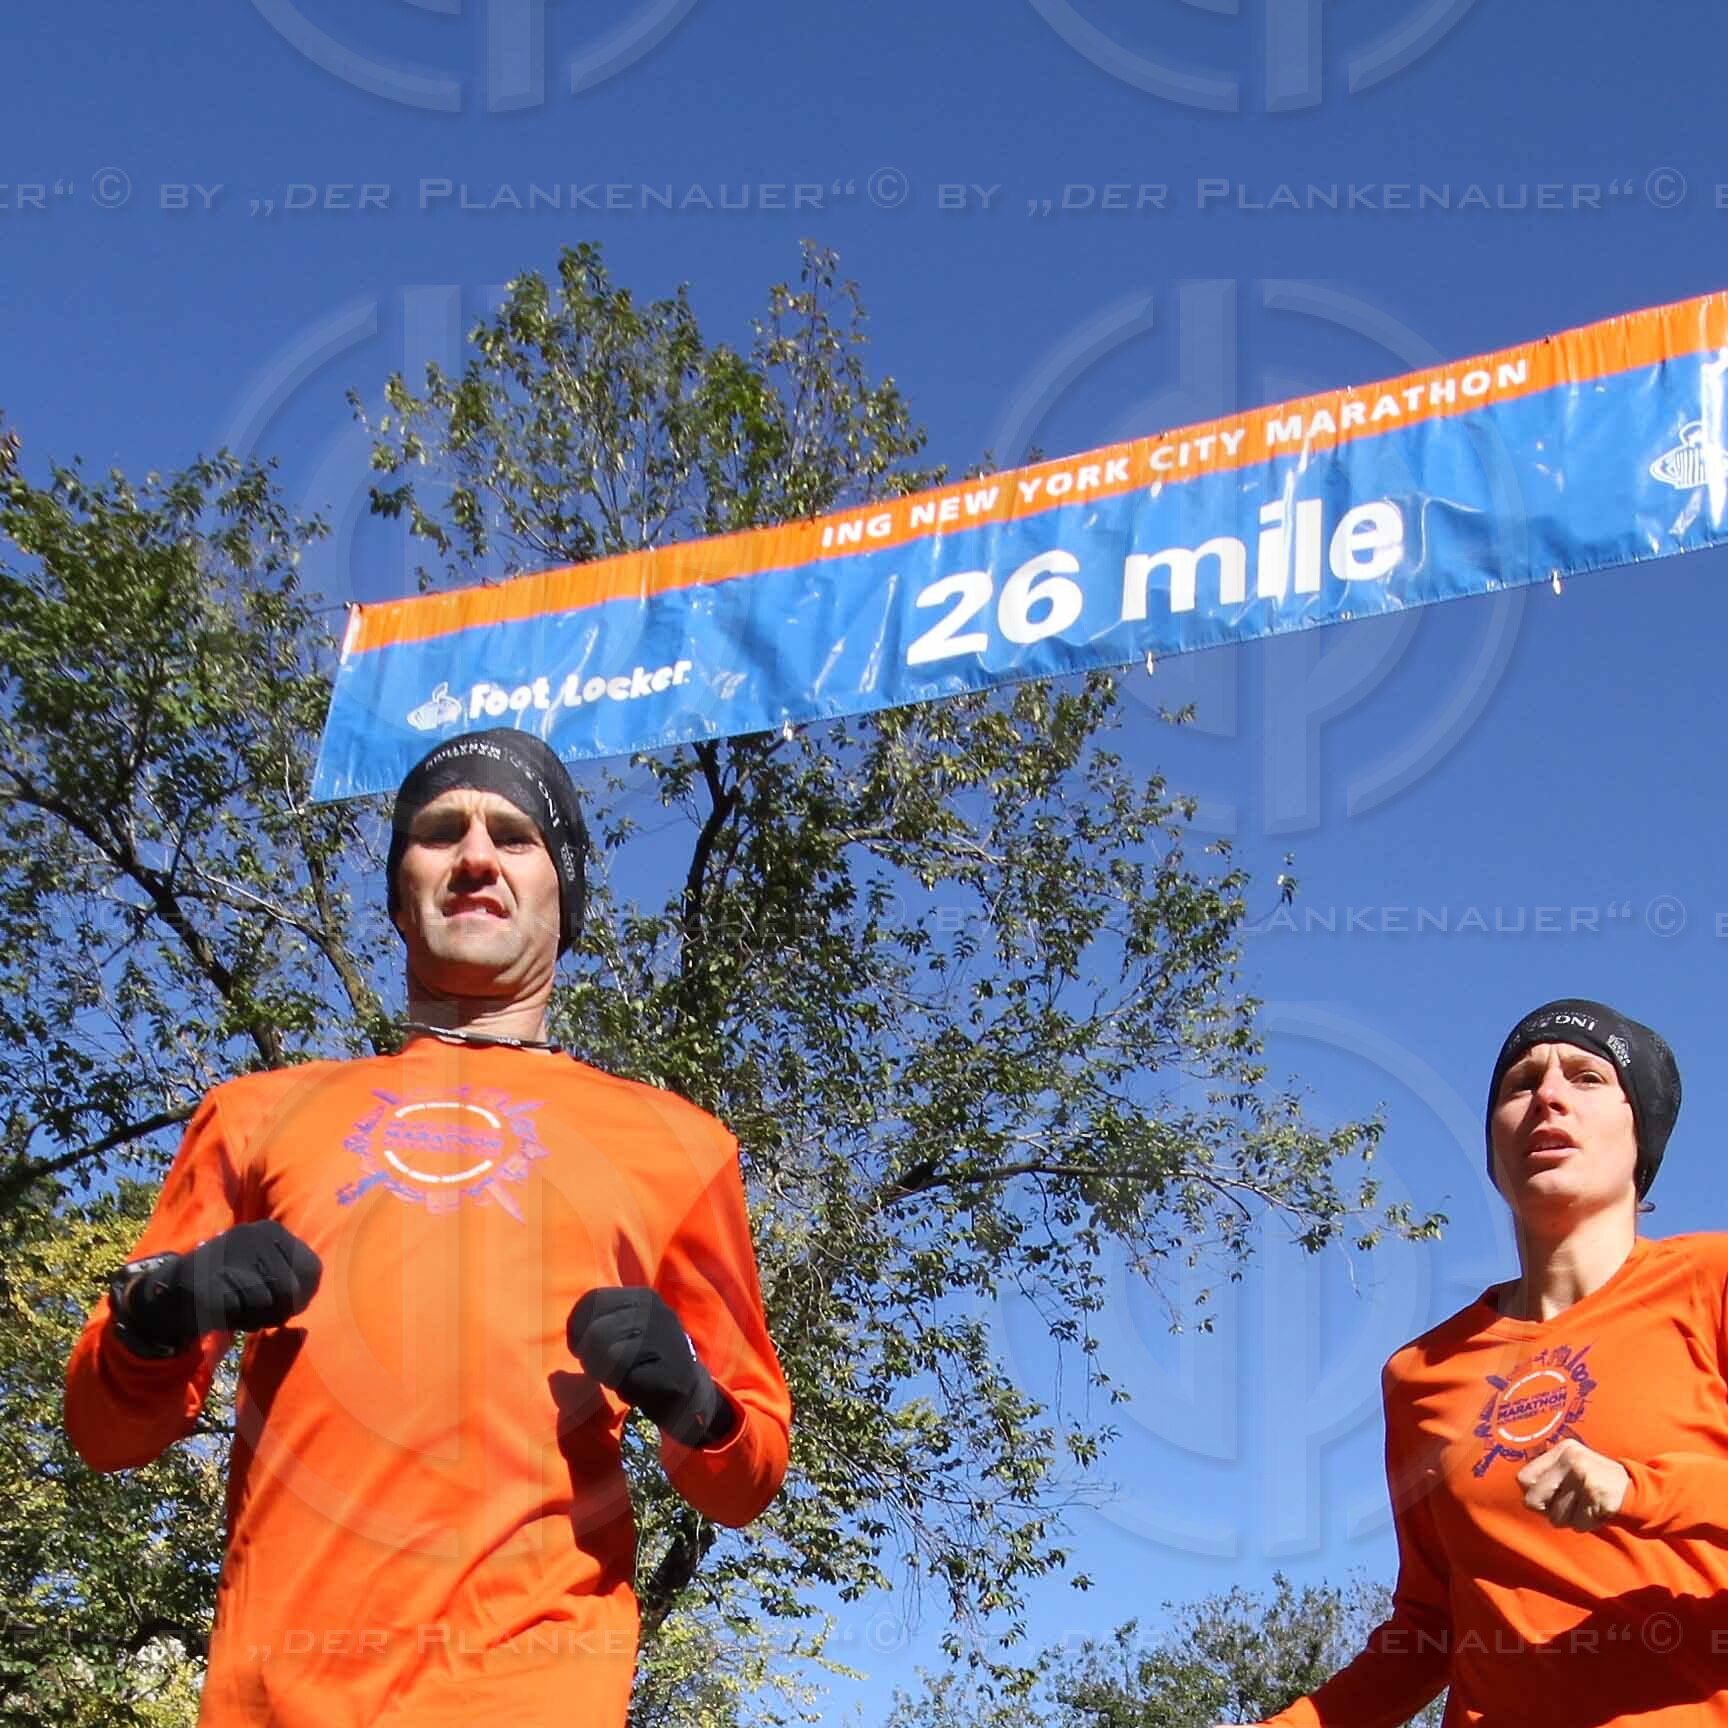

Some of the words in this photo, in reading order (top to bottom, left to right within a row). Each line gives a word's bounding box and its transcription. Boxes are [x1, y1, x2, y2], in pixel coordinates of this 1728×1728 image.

[821, 514, 891, 549] ING
[909, 487, 997, 529] NEW
[1018, 456, 1130, 503] YORK
[1149, 429, 1247, 474] CITY
[1265, 359, 1530, 445] MARATHON
[906, 549, 1083, 665] 26
[1120, 498, 1404, 622] mile
[469, 676, 551, 719] Foot
[563, 659, 693, 707] Locker
